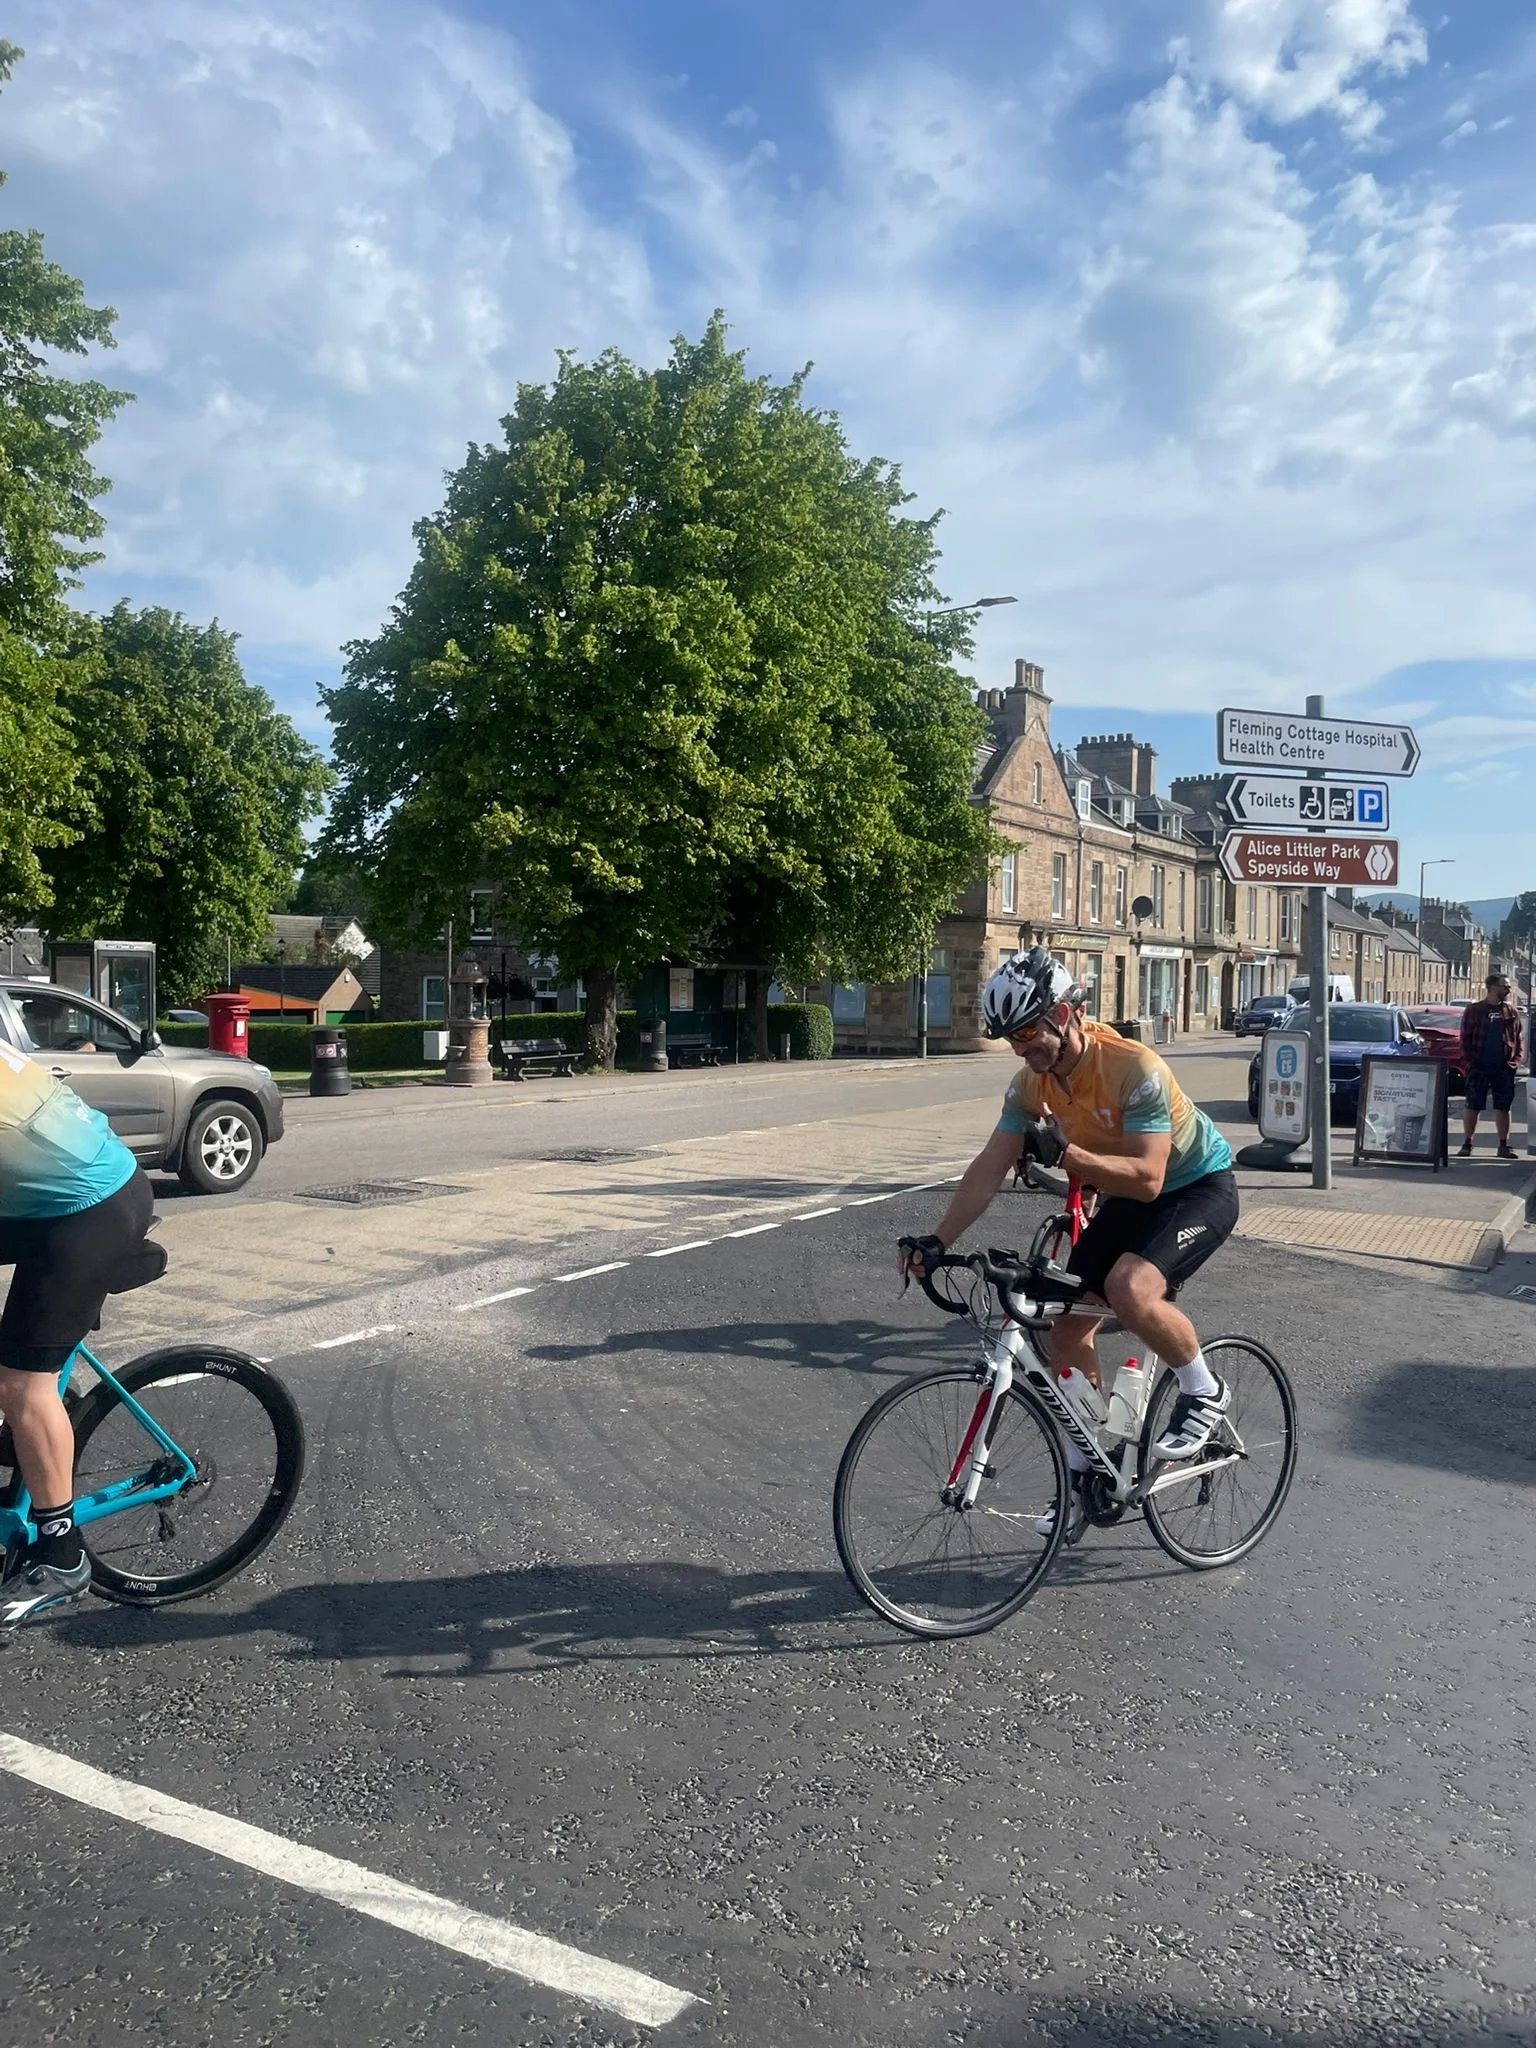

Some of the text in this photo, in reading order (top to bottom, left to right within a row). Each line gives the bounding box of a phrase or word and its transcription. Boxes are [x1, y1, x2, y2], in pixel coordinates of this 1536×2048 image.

[1230, 718, 1397, 749] Fleming Cottage Hospital
[1230, 739, 1325, 760] Health Centre
[1248, 791, 1379, 819] Toilets P
[1247, 840, 1360, 860] Alice Littler Park
[1248, 859, 1341, 880] Speyside Way
[1373, 1089, 1417, 1099] SIGNATURE
[1404, 1121, 1413, 1142] COSTA
